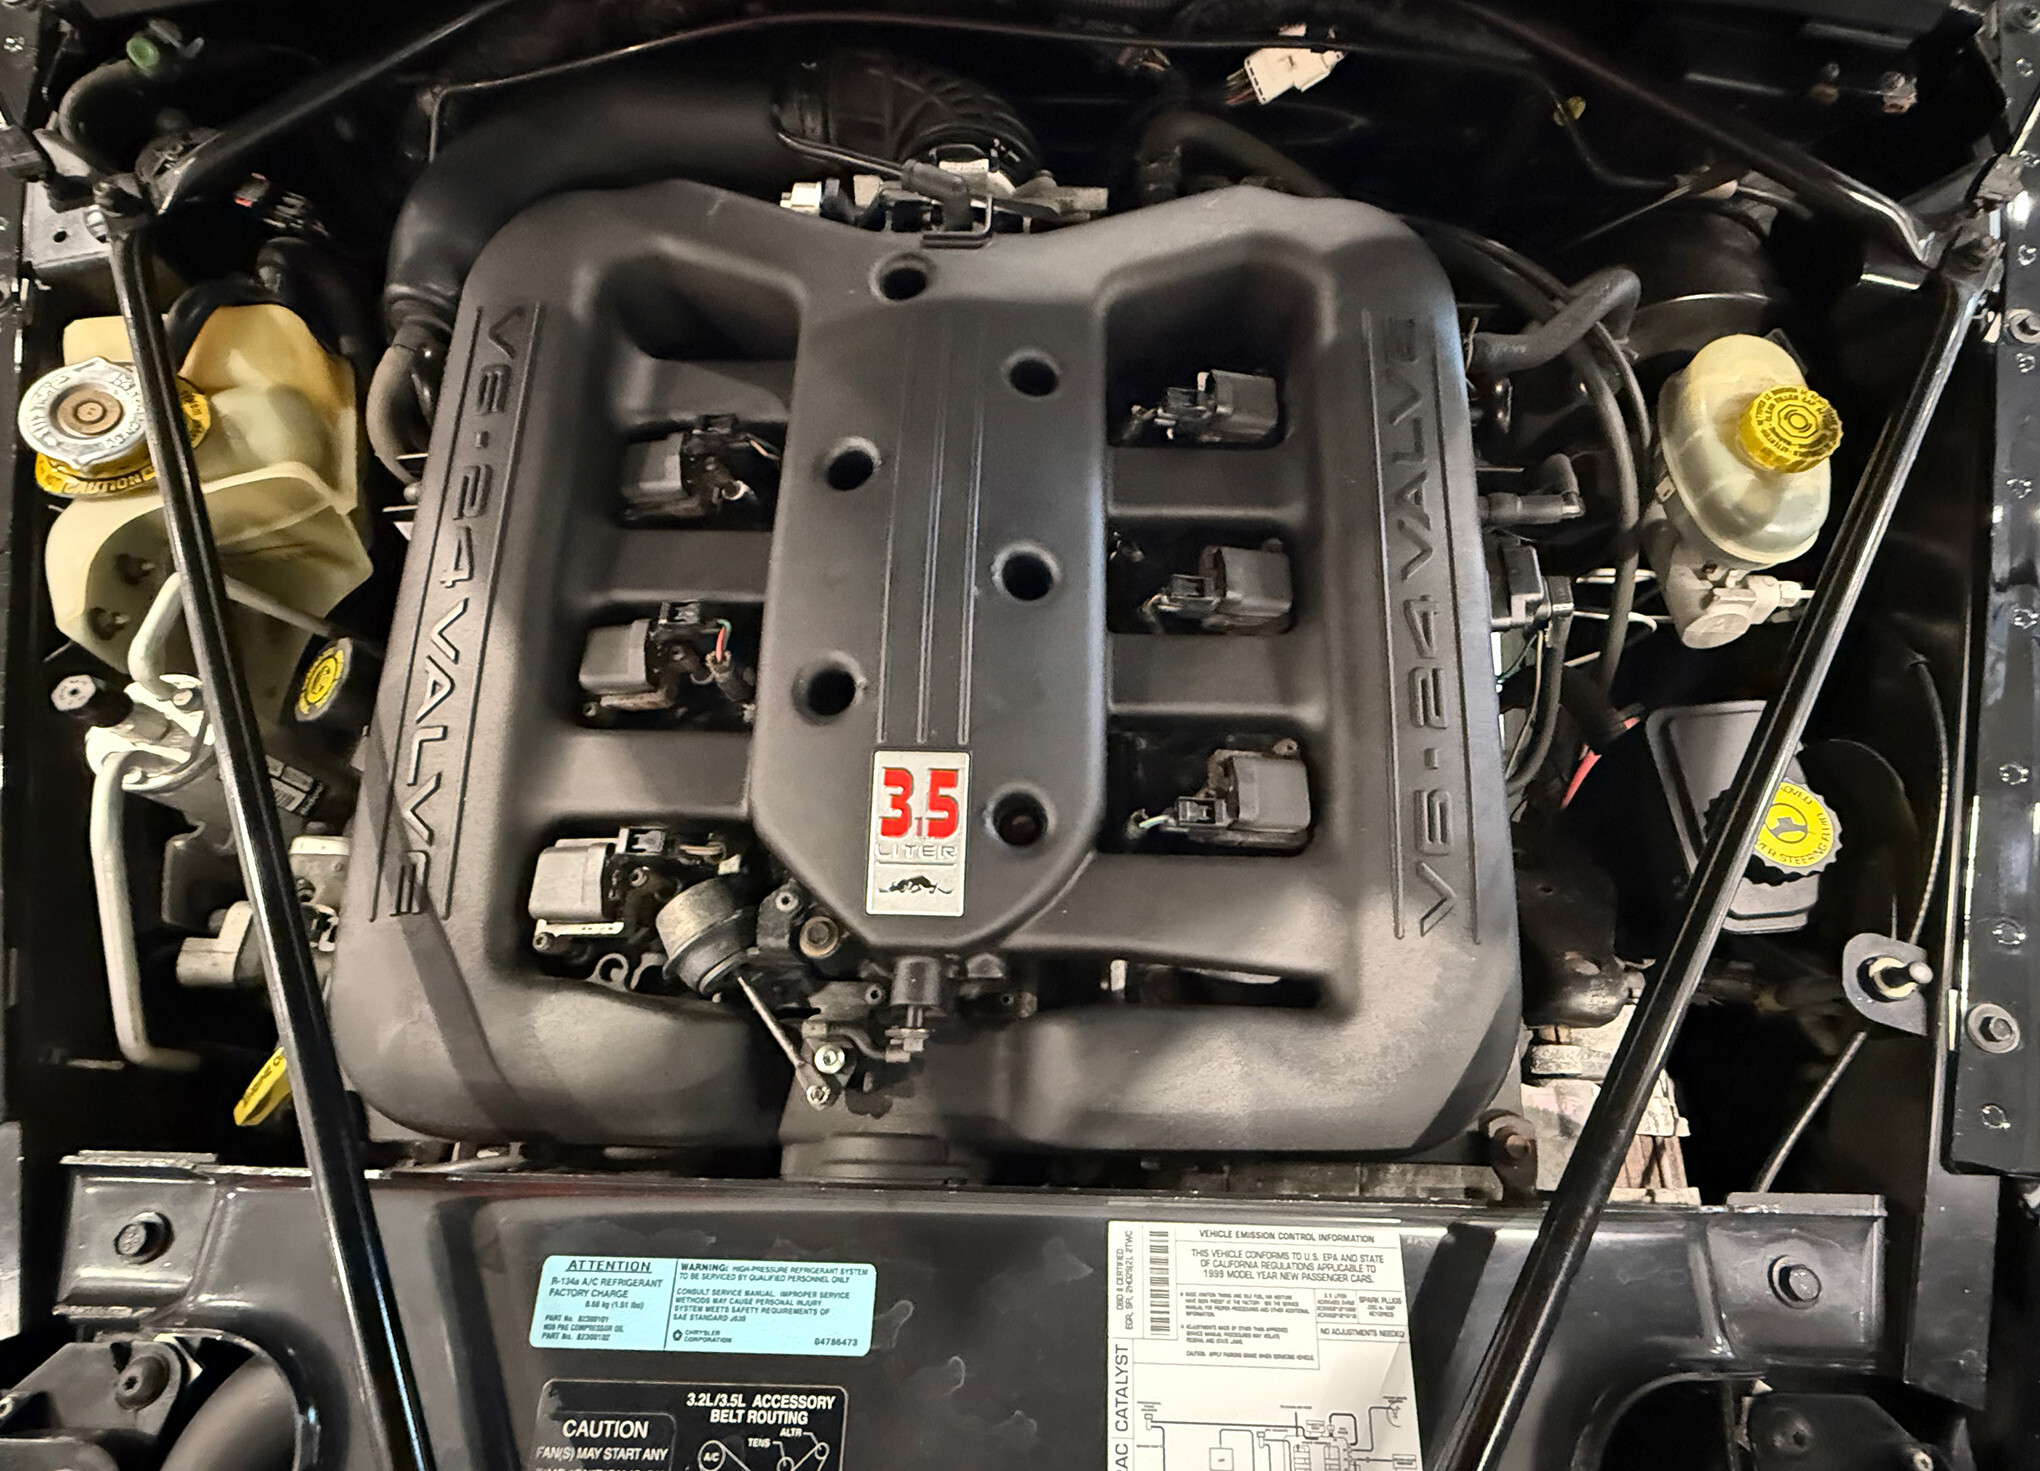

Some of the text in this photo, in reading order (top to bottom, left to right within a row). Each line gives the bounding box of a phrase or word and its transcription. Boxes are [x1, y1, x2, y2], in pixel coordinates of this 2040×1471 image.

[879, 767, 960, 839] 3.5
[874, 843, 959, 859] LITER
[1199, 1230, 1375, 1243] VEHICLE EMISSION CONTROL INFORMATION
[1191, 1249, 1384, 1264] THIS VEHICLE CONFORMS TO U.S. EPA AND STATE
[568, 1260, 651, 1272] ATTENTION
[681, 1263, 869, 1276] WARNING: HIGH-PRESSURE REFRIGERANT SYSTEM
[1116, 1248, 1124, 1286] CERTIFIED
[1200, 1259, 1377, 1273] OF CALIFORNIA REGULATIONS APPLICABLE TO
[701, 1273, 737, 1281] SERVICED
[749, 1274, 786, 1282] QUALIFIED
[787, 1275, 830, 1283] PERSONNEL
[1203, 1269, 1375, 1284] 1999 MODEL YEAR NEW PASSENGER CARS.
[582, 1277, 598, 1286] A/C
[600, 1278, 664, 1288] REFRIGERANT
[549, 1288, 629, 1298] FACTORY CHARGE
[676, 1288, 710, 1296] CONSULT
[755, 1298, 794, 1306] PERSONAL
[1359, 1296, 1380, 1305] SPARK
[1382, 1297, 1402, 1306] PLUGS
[731, 1306, 759, 1314] SAFETY
[760, 1307, 818, 1315] REQUIREMENTS
[819, 1308, 830, 1316] OF
[673, 1313, 687, 1321] SAE
[689, 1314, 729, 1322] STANDARD
[571, 1324, 613, 1332] COMPRESSOR
[1320, 1328, 1405, 1339] NO ADJUSTMENTS NEEDED
[541, 1332, 560, 1340] PART
[1115, 1343, 1128, 1432] CATALYST
[686, 1392, 836, 1410] 3.2L/3.5L ACCESSORY
[709, 1409, 809, 1425] BELT ROUTING
[562, 1419, 649, 1439] CAUTION
[779, 1428, 803, 1438] ALTR
[747, 1438, 771, 1448] TENS
[536, 1446, 669, 1462] FAN(S) MAY START ANY
[703, 1452, 720, 1462] A/C
